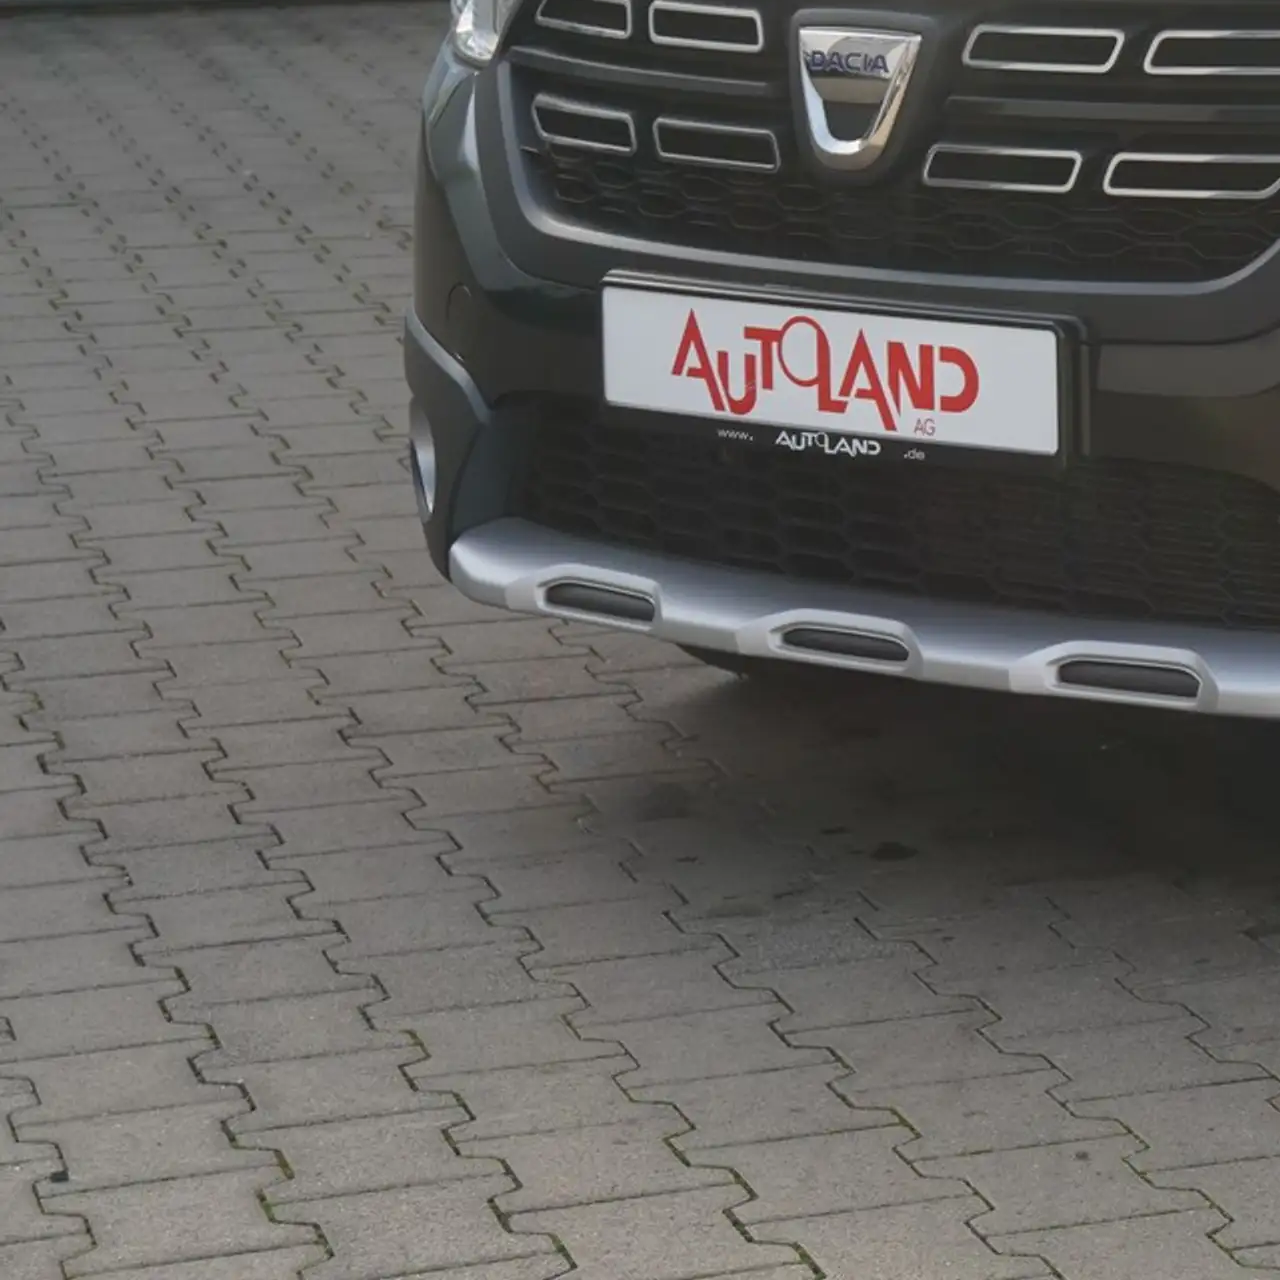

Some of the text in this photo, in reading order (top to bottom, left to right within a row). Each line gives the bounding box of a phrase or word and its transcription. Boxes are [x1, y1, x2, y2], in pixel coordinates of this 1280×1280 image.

[810, 50, 889, 73] DACIA
[913, 417, 936, 437] AG
[717, 427, 754, 442] www.
[903, 447, 925, 461] .de
